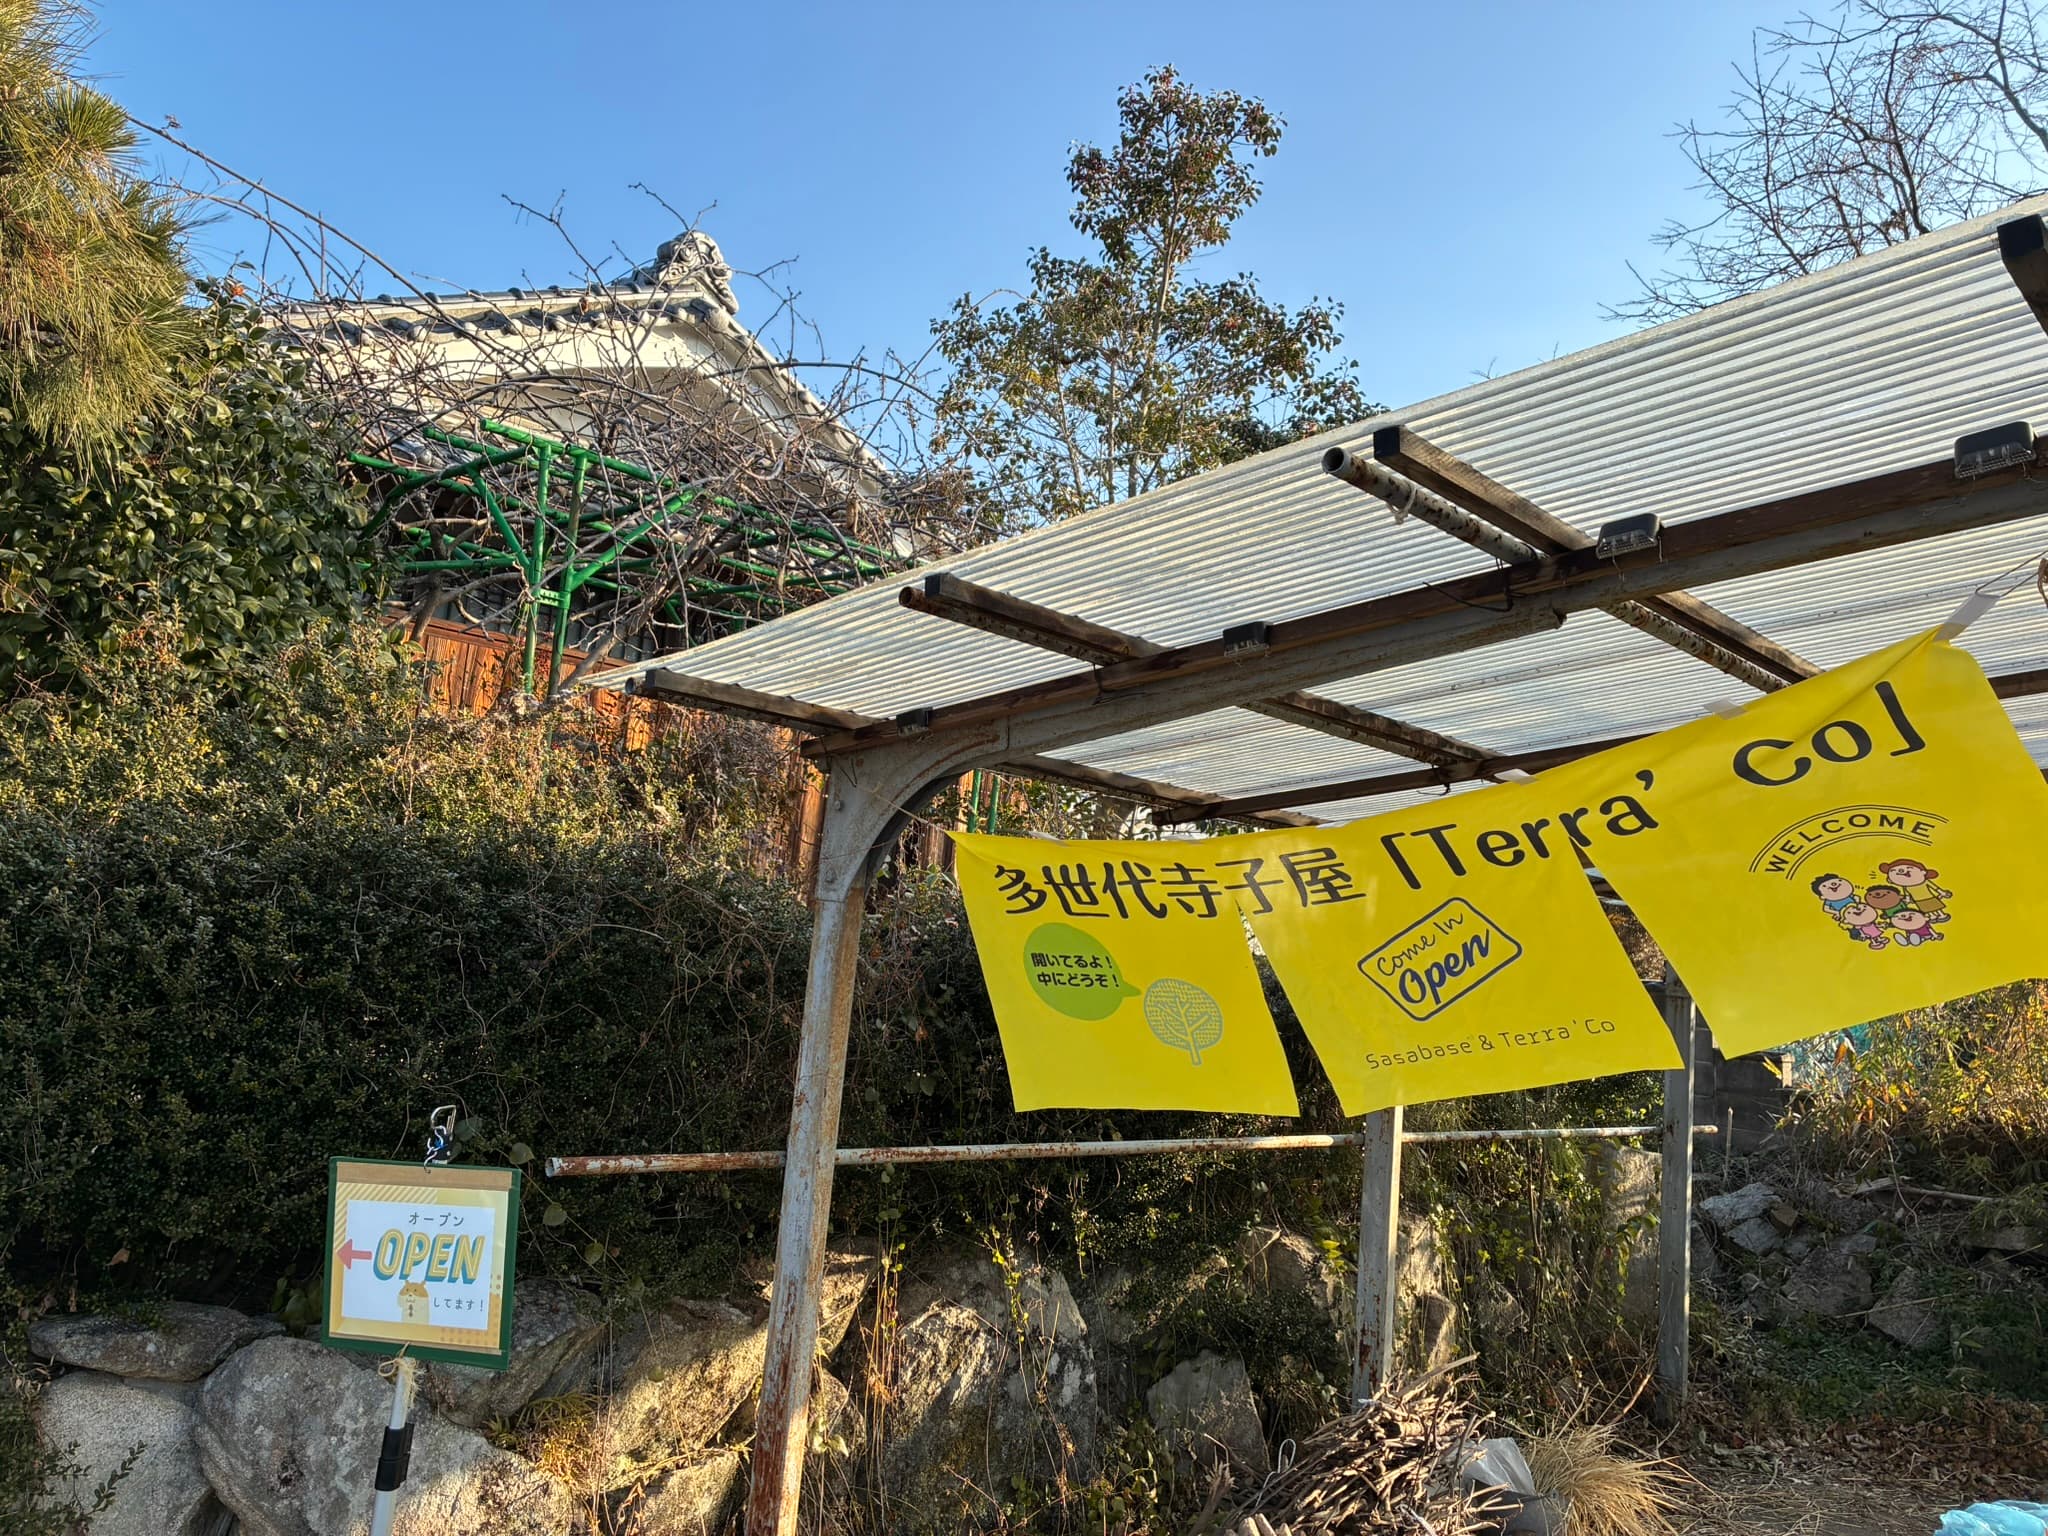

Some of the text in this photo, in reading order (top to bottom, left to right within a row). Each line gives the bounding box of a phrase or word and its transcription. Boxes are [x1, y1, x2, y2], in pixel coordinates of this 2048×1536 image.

[1764, 812, 1936, 874] WELCOME
[994, 847, 1366, 919] 多世代寺子屋
[1031, 952, 1112, 969] 開いてるよ！
[1376, 911, 1464, 977] Come In
[1399, 929, 1491, 1005] Open
[1037, 971, 1119, 987] 中にどうぞ！
[1366, 1040, 1471, 1070] Sasabase
[1478, 1033, 1496, 1051] &
[1584, 1018, 1616, 1036] Co
[408, 1211, 464, 1227] オープン
[373, 1229, 485, 1284] OPEN
[433, 1297, 484, 1312] してます！
